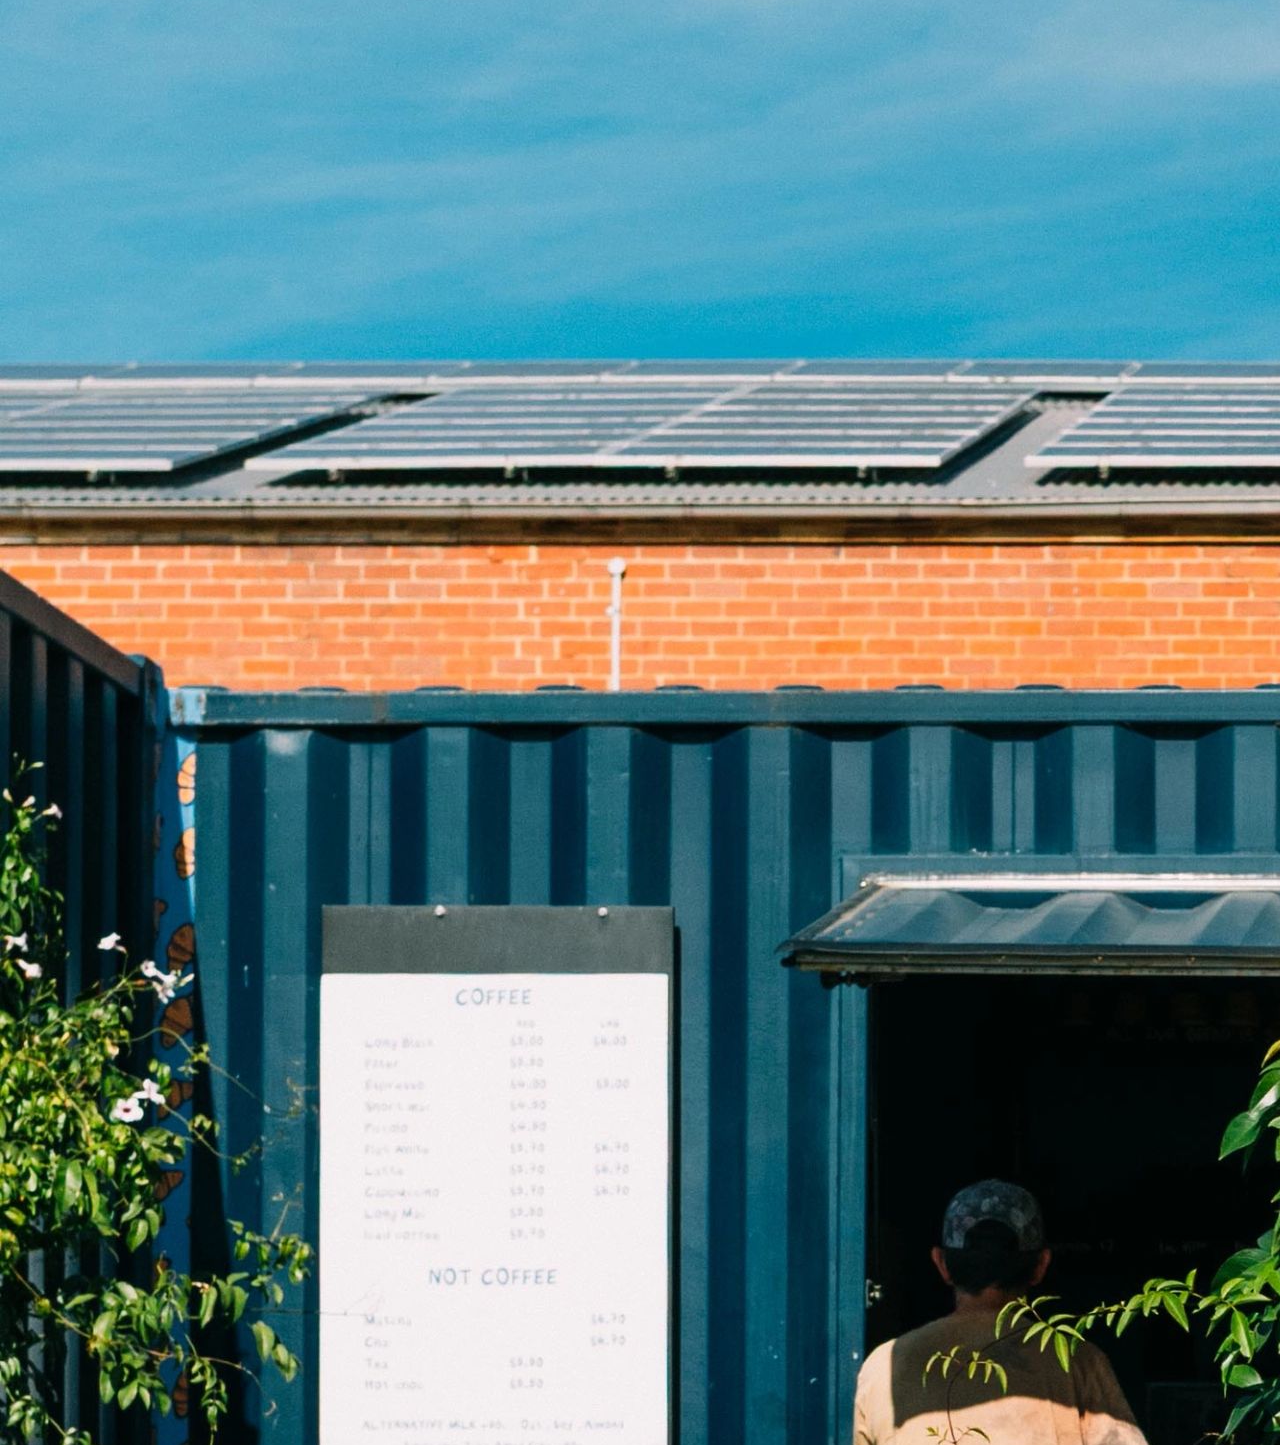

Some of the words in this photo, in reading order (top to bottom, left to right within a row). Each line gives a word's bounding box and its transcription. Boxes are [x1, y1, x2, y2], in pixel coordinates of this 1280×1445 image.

[456, 987, 533, 1006] COFFEE
[429, 1268, 471, 1286] NOT
[480, 1267, 558, 1287] COFFEE
